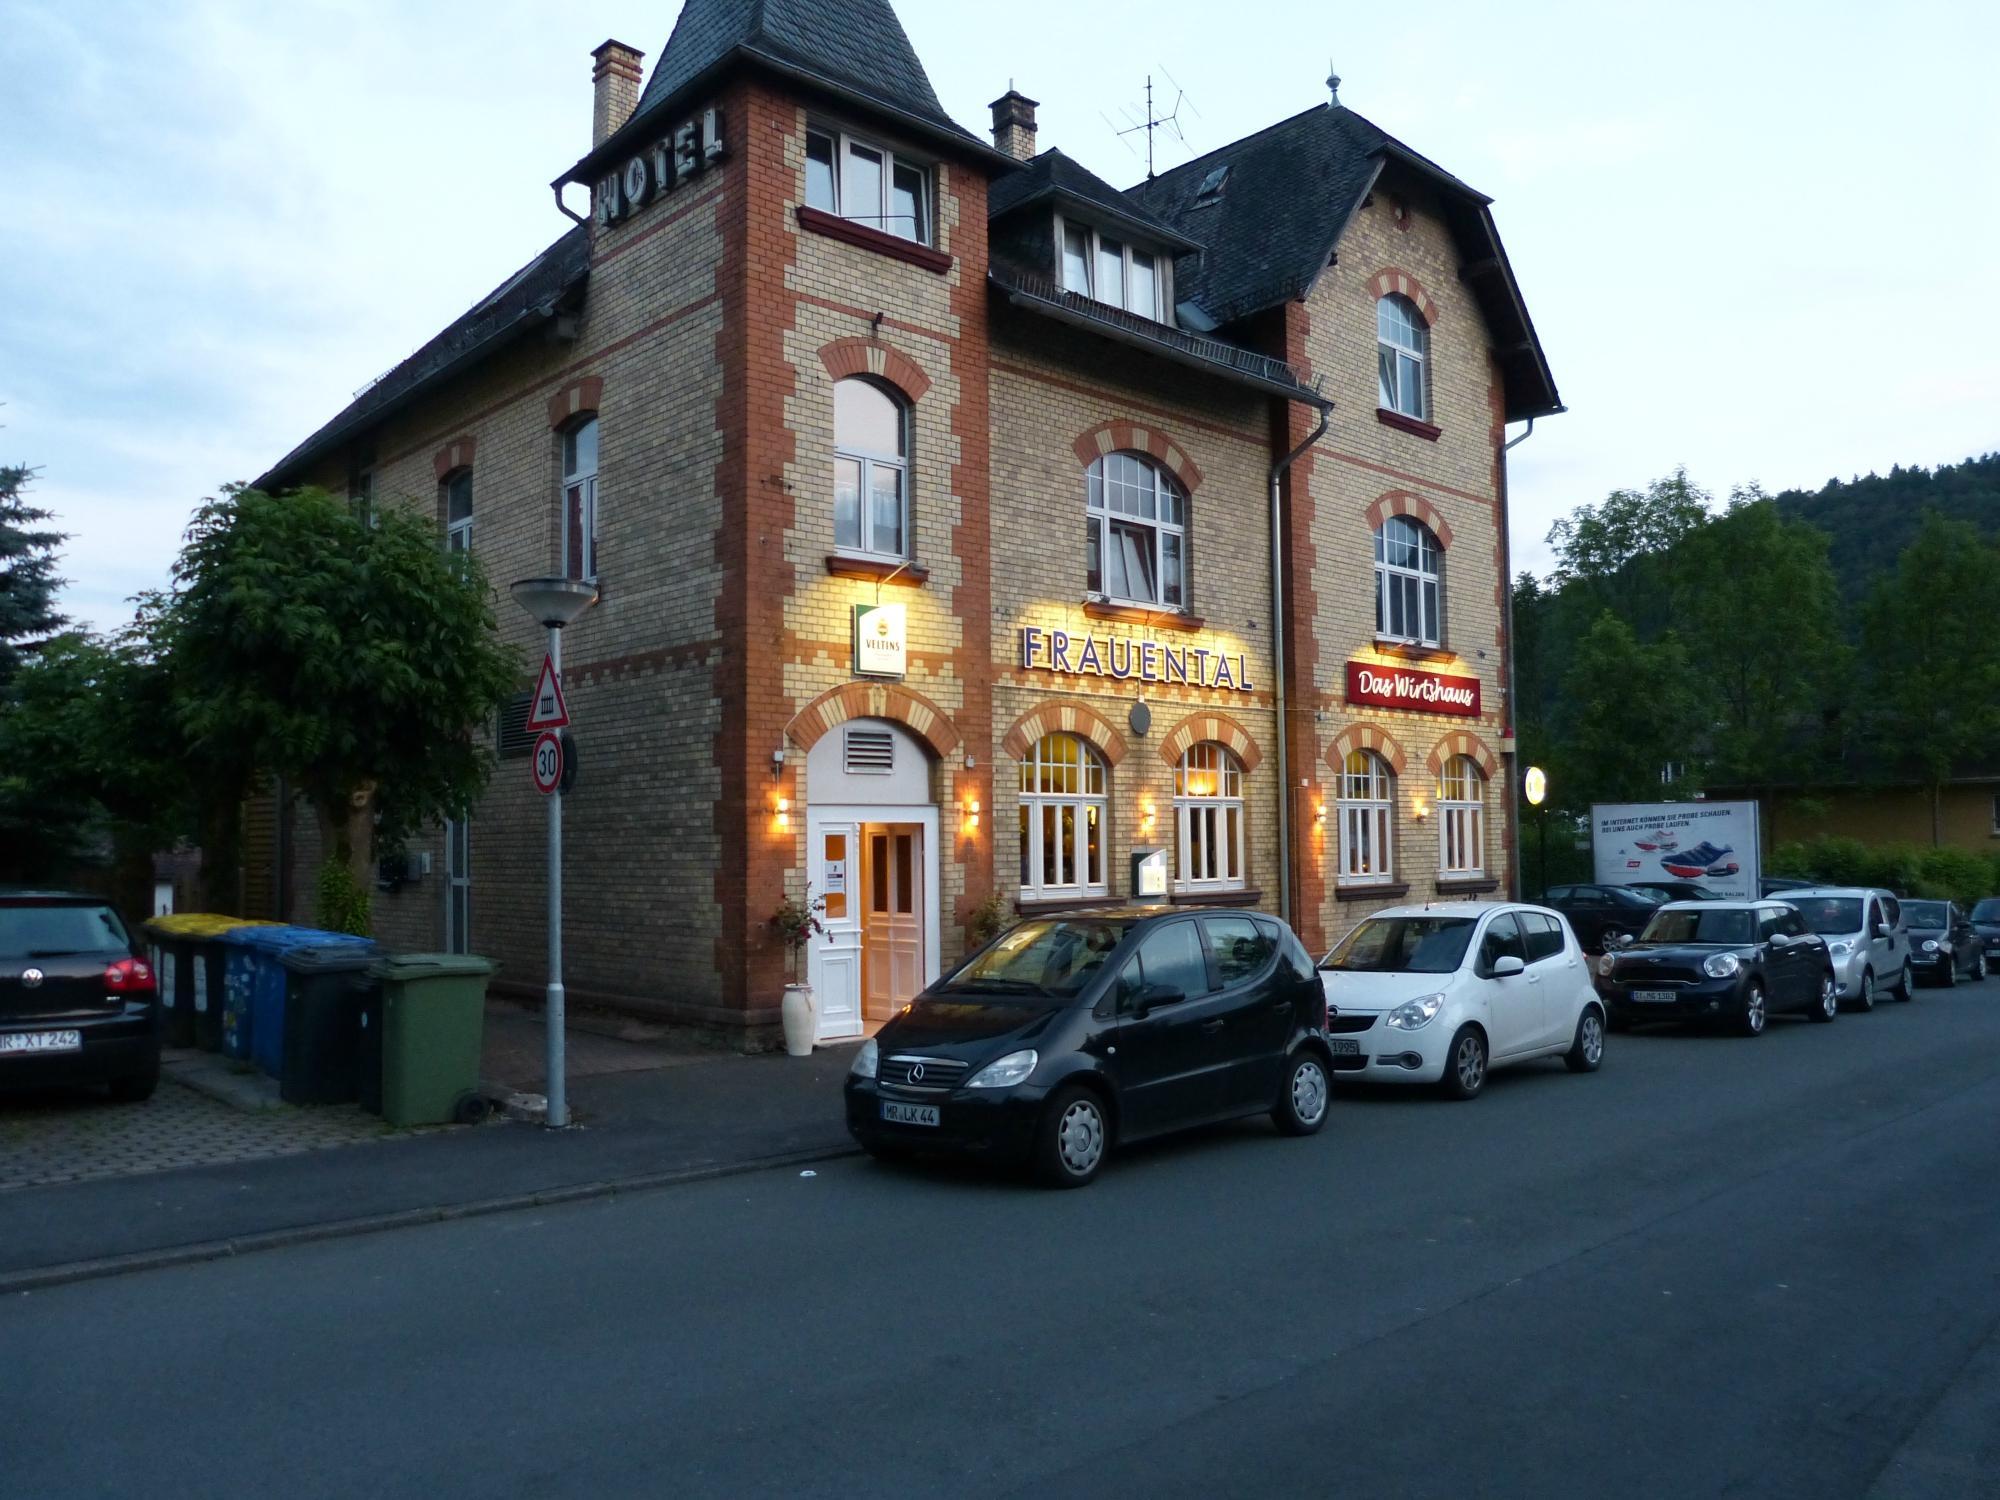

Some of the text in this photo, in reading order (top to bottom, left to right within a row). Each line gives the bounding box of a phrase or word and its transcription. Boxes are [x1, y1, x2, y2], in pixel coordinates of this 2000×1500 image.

[597, 107, 723, 227] HOTEL
[866, 639, 900, 651] VELTINS
[1024, 626, 1253, 690] FRAUENTAL
[1358, 670, 1474, 706] Das Wirtshaus
[539, 749, 556, 777] 30
[1610, 818, 1639, 826] INTERNET
[1678, 812, 1698, 820] PROBE
[1626, 824, 1643, 832] AUCH
[1644, 822, 1664, 831] PROBE
[48, 1030, 77, 1046] 242
[904, 1106, 918, 1122] LK
[920, 1108, 935, 1124] 44
